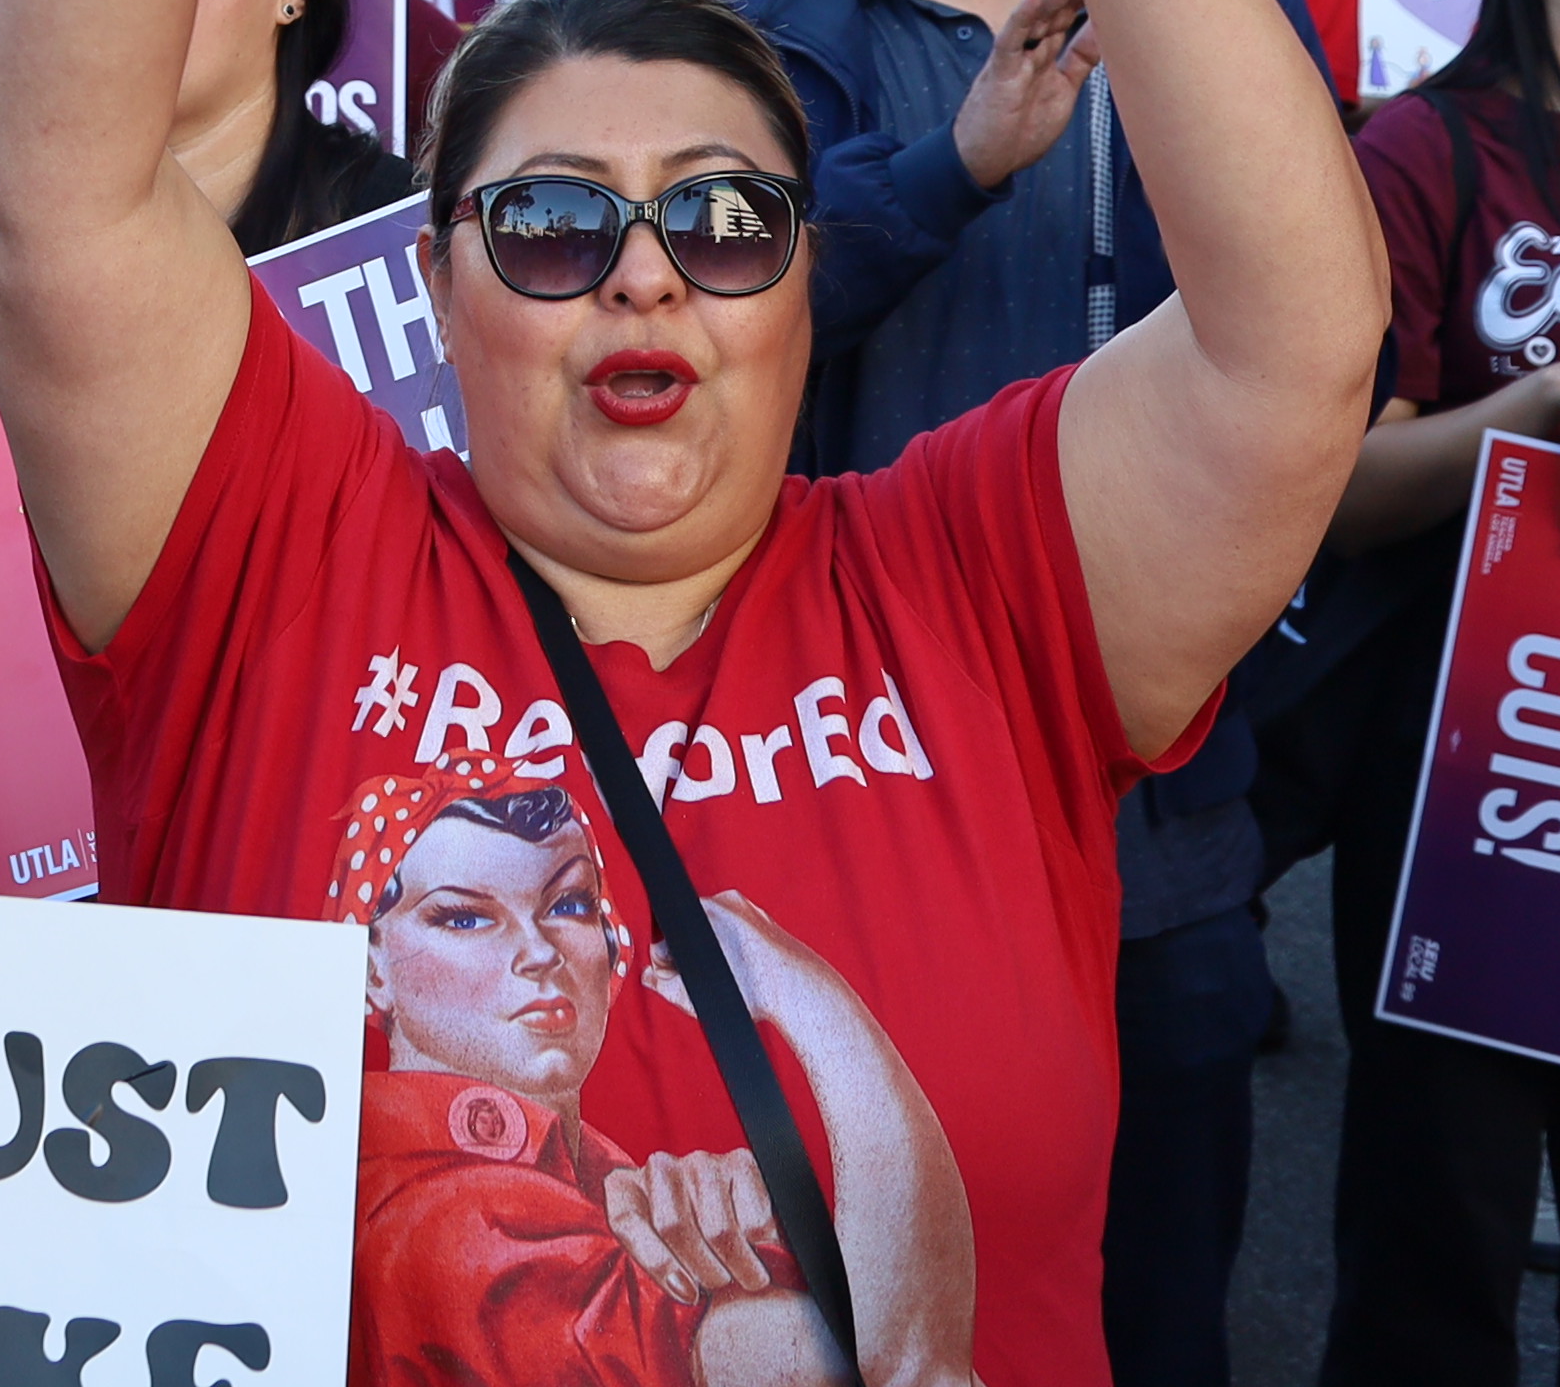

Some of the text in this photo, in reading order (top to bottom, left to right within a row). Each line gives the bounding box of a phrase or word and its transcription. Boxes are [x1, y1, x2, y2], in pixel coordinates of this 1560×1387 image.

[298, 243, 441, 393] TH
[1494, 456, 1528, 508] UTLA
[9, 838, 81, 884] UTLA
[1420, 938, 1440, 982] SEIU
